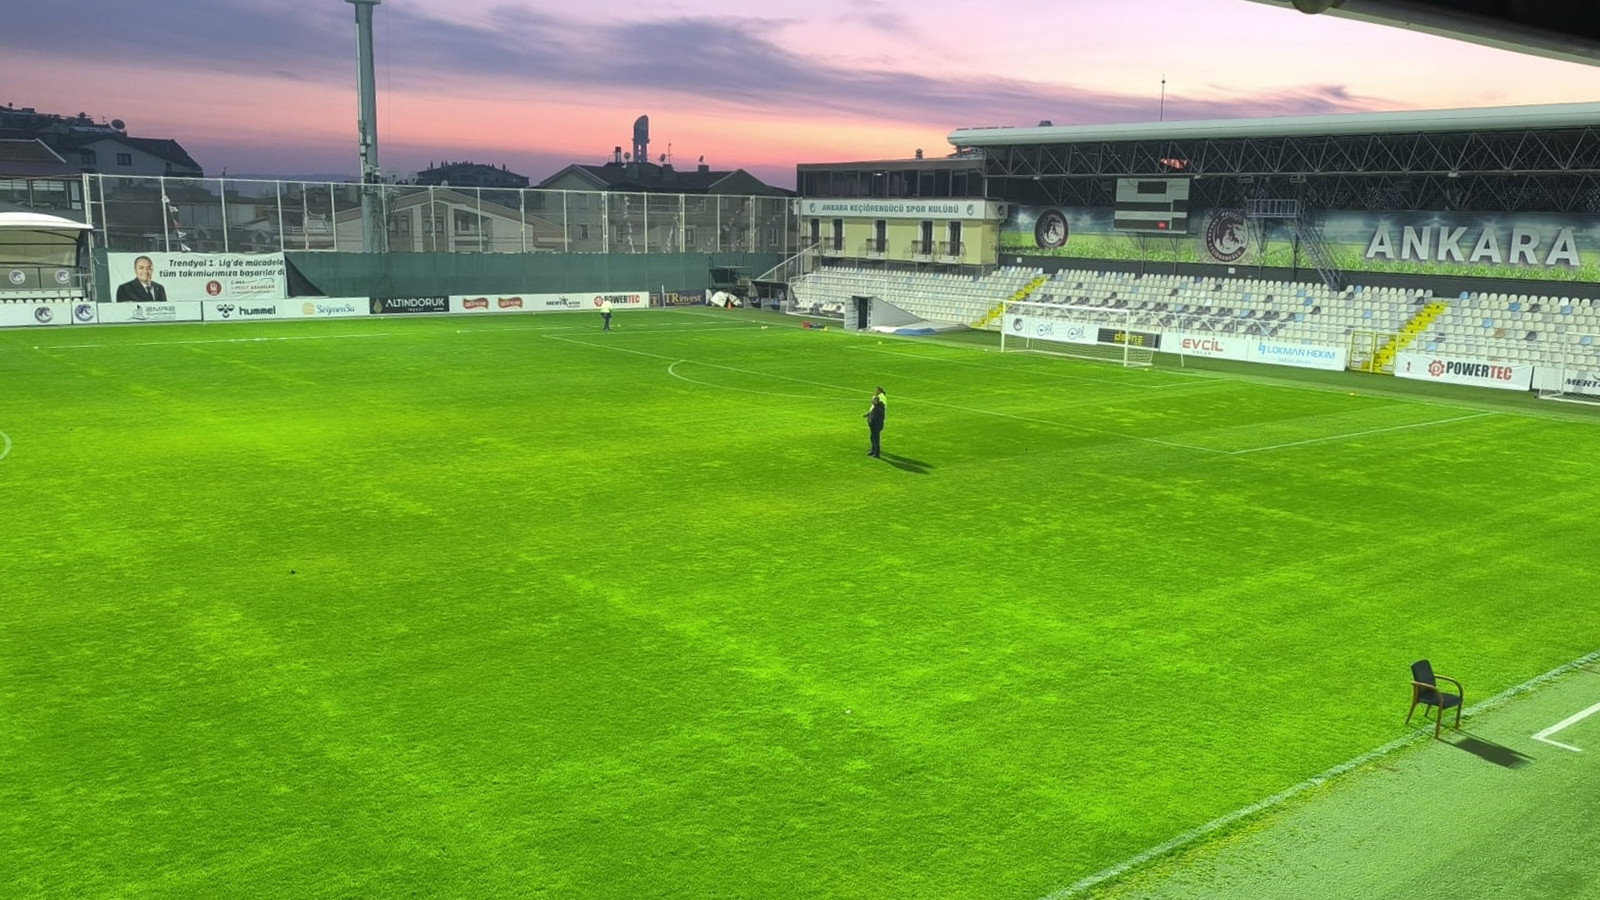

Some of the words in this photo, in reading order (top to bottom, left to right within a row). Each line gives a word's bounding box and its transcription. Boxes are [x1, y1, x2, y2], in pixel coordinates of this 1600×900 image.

[822, 203, 849, 212] ANKARA
[906, 205, 926, 213] SPOR
[928, 204, 959, 214] KULÜBÜ
[1365, 225, 1581, 267] ANKARA
[169, 259, 207, 269] Trendyol
[218, 259, 244, 269] Lig'de
[159, 269, 177, 278] tüm
[385, 297, 445, 308] ALTINDORUK
[239, 305, 276, 316] hummel
[1182, 337, 1224, 352] EVCİL
[1267, 346, 1305, 357] LOKMAN
[1306, 349, 1336, 360] HEKİM
[1445, 361, 1512, 381] POWERTEC
